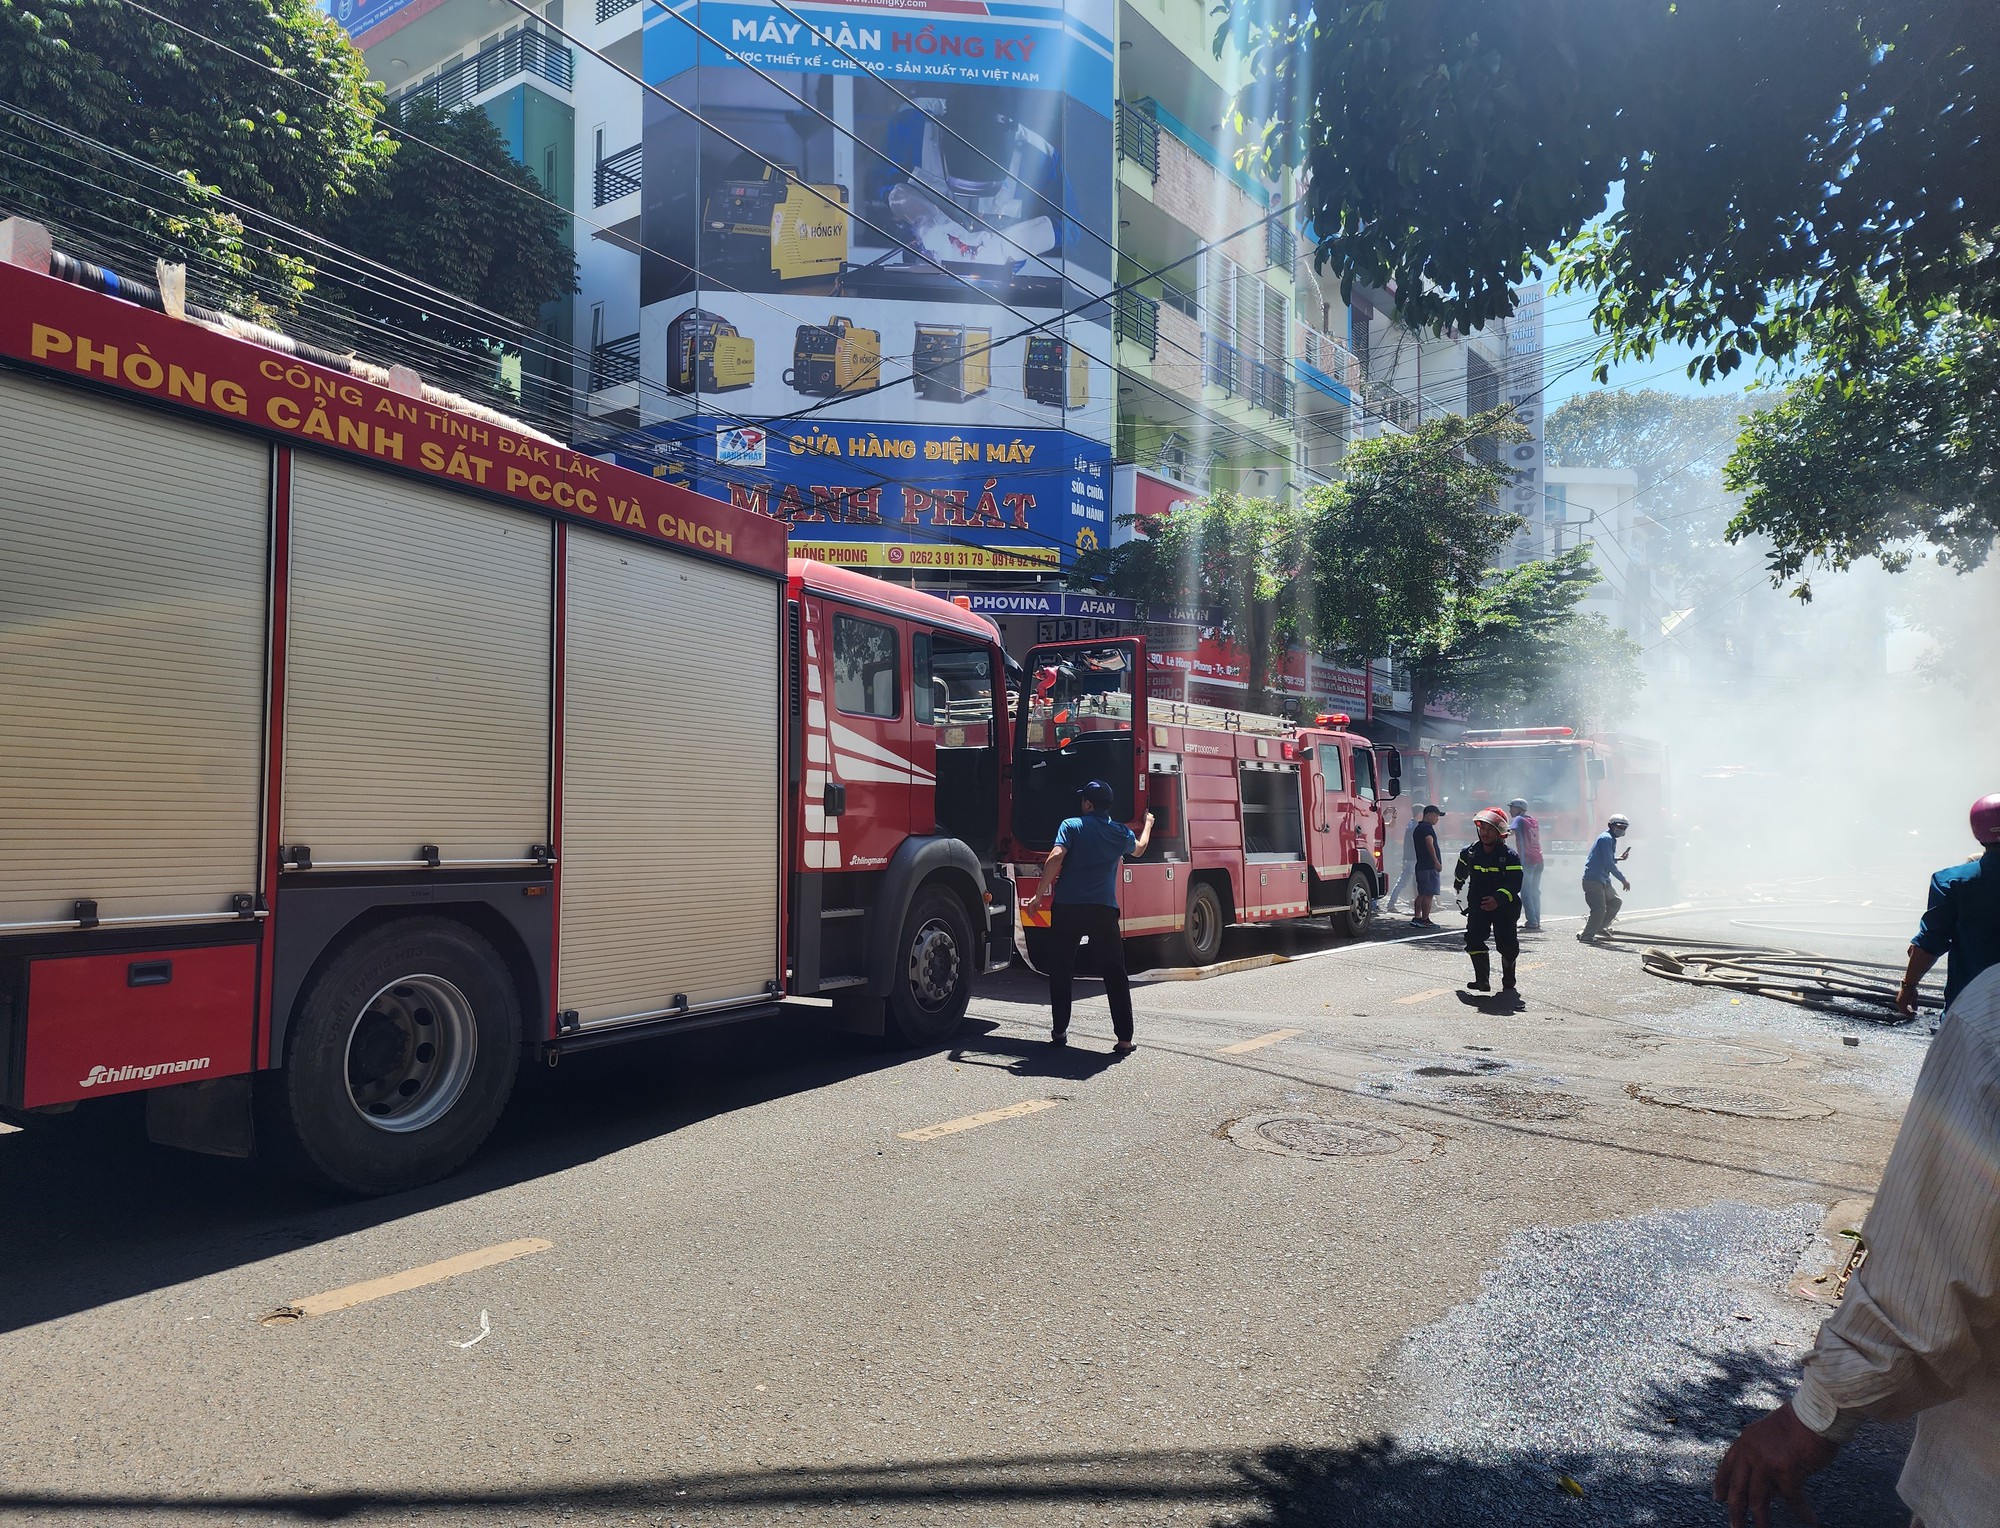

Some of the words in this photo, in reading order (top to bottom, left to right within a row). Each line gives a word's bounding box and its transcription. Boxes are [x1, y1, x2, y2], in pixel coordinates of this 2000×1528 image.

[846, 0, 927, 8] .ongky.com
[732, 15, 802, 45] MÁY
[811, 21, 881, 51] HÀN
[891, 24, 984, 58] HỒNG
[994, 35, 1037, 62] KÝ
[725, 52, 762, 64] ĐƯỢC
[765, 53, 802, 66] THIẾT
[804, 54, 822, 67] KẾ
[861, 61, 884, 73] TẠO
[895, 60, 921, 74] SẢN
[924, 63, 957, 77] XUẤT
[960, 68, 979, 79] TẠI
[982, 69, 1009, 81] VIỆT
[1012, 72, 1040, 82] NAM
[259, 360, 363, 407] CÔNG
[375, 398, 418, 424] AN
[424, 411, 489, 446] TỈNH
[498, 435, 549, 467] ĐẮK
[555, 453, 601, 482] LẮK
[31, 322, 249, 416] PHÒNG
[266, 396, 404, 460] CẢNH
[419, 441, 493, 484] SÁT
[506, 466, 598, 515] PCCC
[606, 495, 647, 529] VÀ
[657, 513, 734, 558] CNCH
[789, 426, 842, 456] CỬA
[848, 433, 916, 459] HÀNG
[924, 436, 980, 465] ĐIỆN
[986, 439, 1035, 464] MÁY
[1071, 477, 1085, 496] SỬA
[1086, 484, 1104, 501] CHỮA
[727, 482, 882, 532] MẠNH
[901, 478, 1037, 529] PHÁT
[1071, 499, 1085, 517] BẢO
[1086, 505, 1104, 523] HÀNH
[794, 543, 826, 561] HỒNG
[828, 548, 868, 563] PHONG
[910, 550, 933, 565] 0262
[935, 551, 942, 565] 3
[944, 551, 957, 565] 91
[958, 552, 970, 565] 31
[971, 552, 983, 566] 79
[1080, 600, 1116, 615] AFAN
[850, 855, 888, 866] Schlingmann
[79, 1057, 211, 1088] Schlingmann
